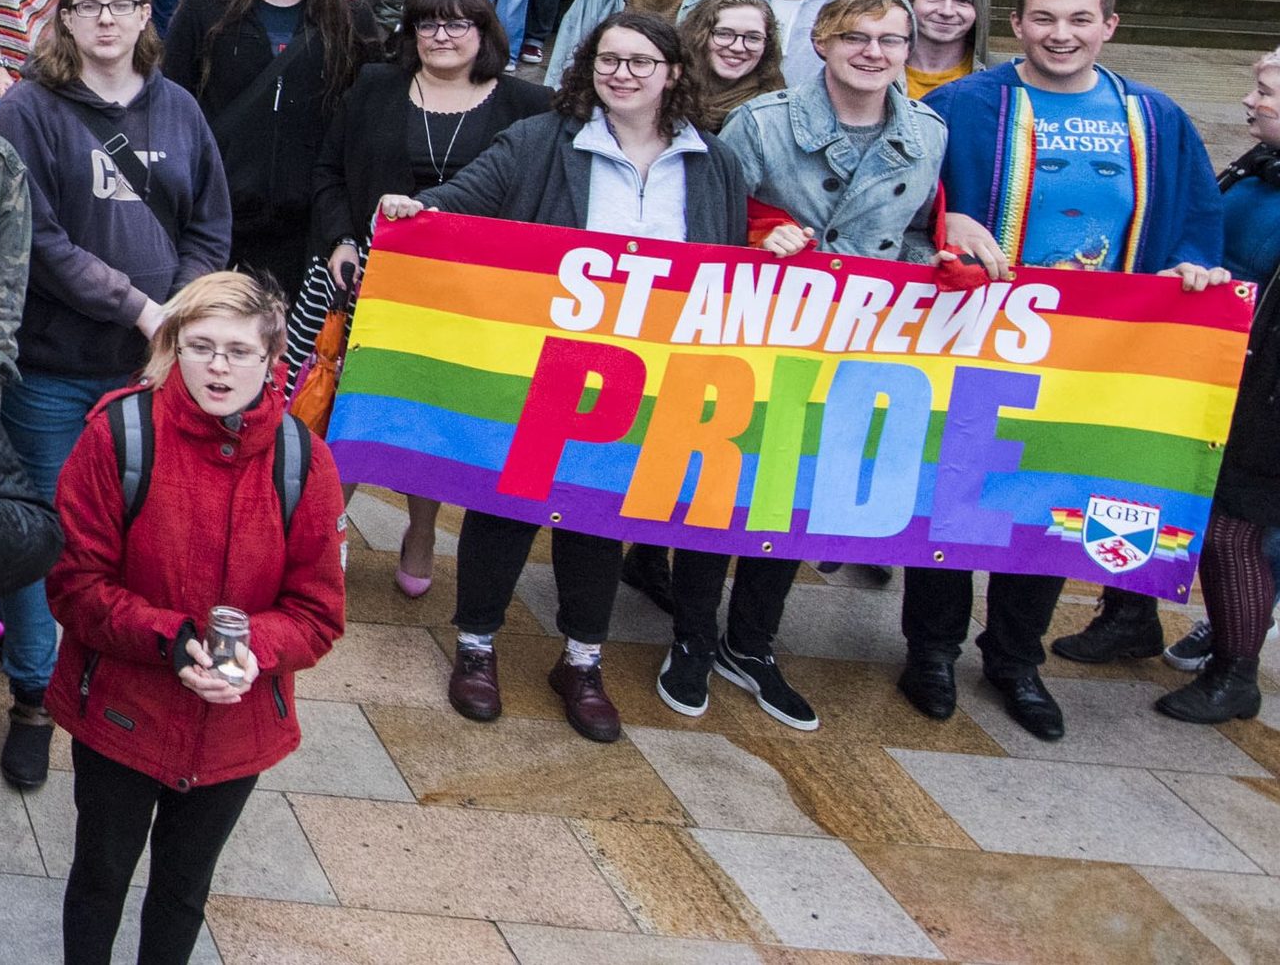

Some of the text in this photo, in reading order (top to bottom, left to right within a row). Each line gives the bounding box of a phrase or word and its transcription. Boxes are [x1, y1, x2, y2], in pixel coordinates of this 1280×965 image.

[550, 247, 1061, 364] ST ANDREWS
[496, 335, 1041, 547] PRIDE
[1092, 502, 1156, 526] LGBT
